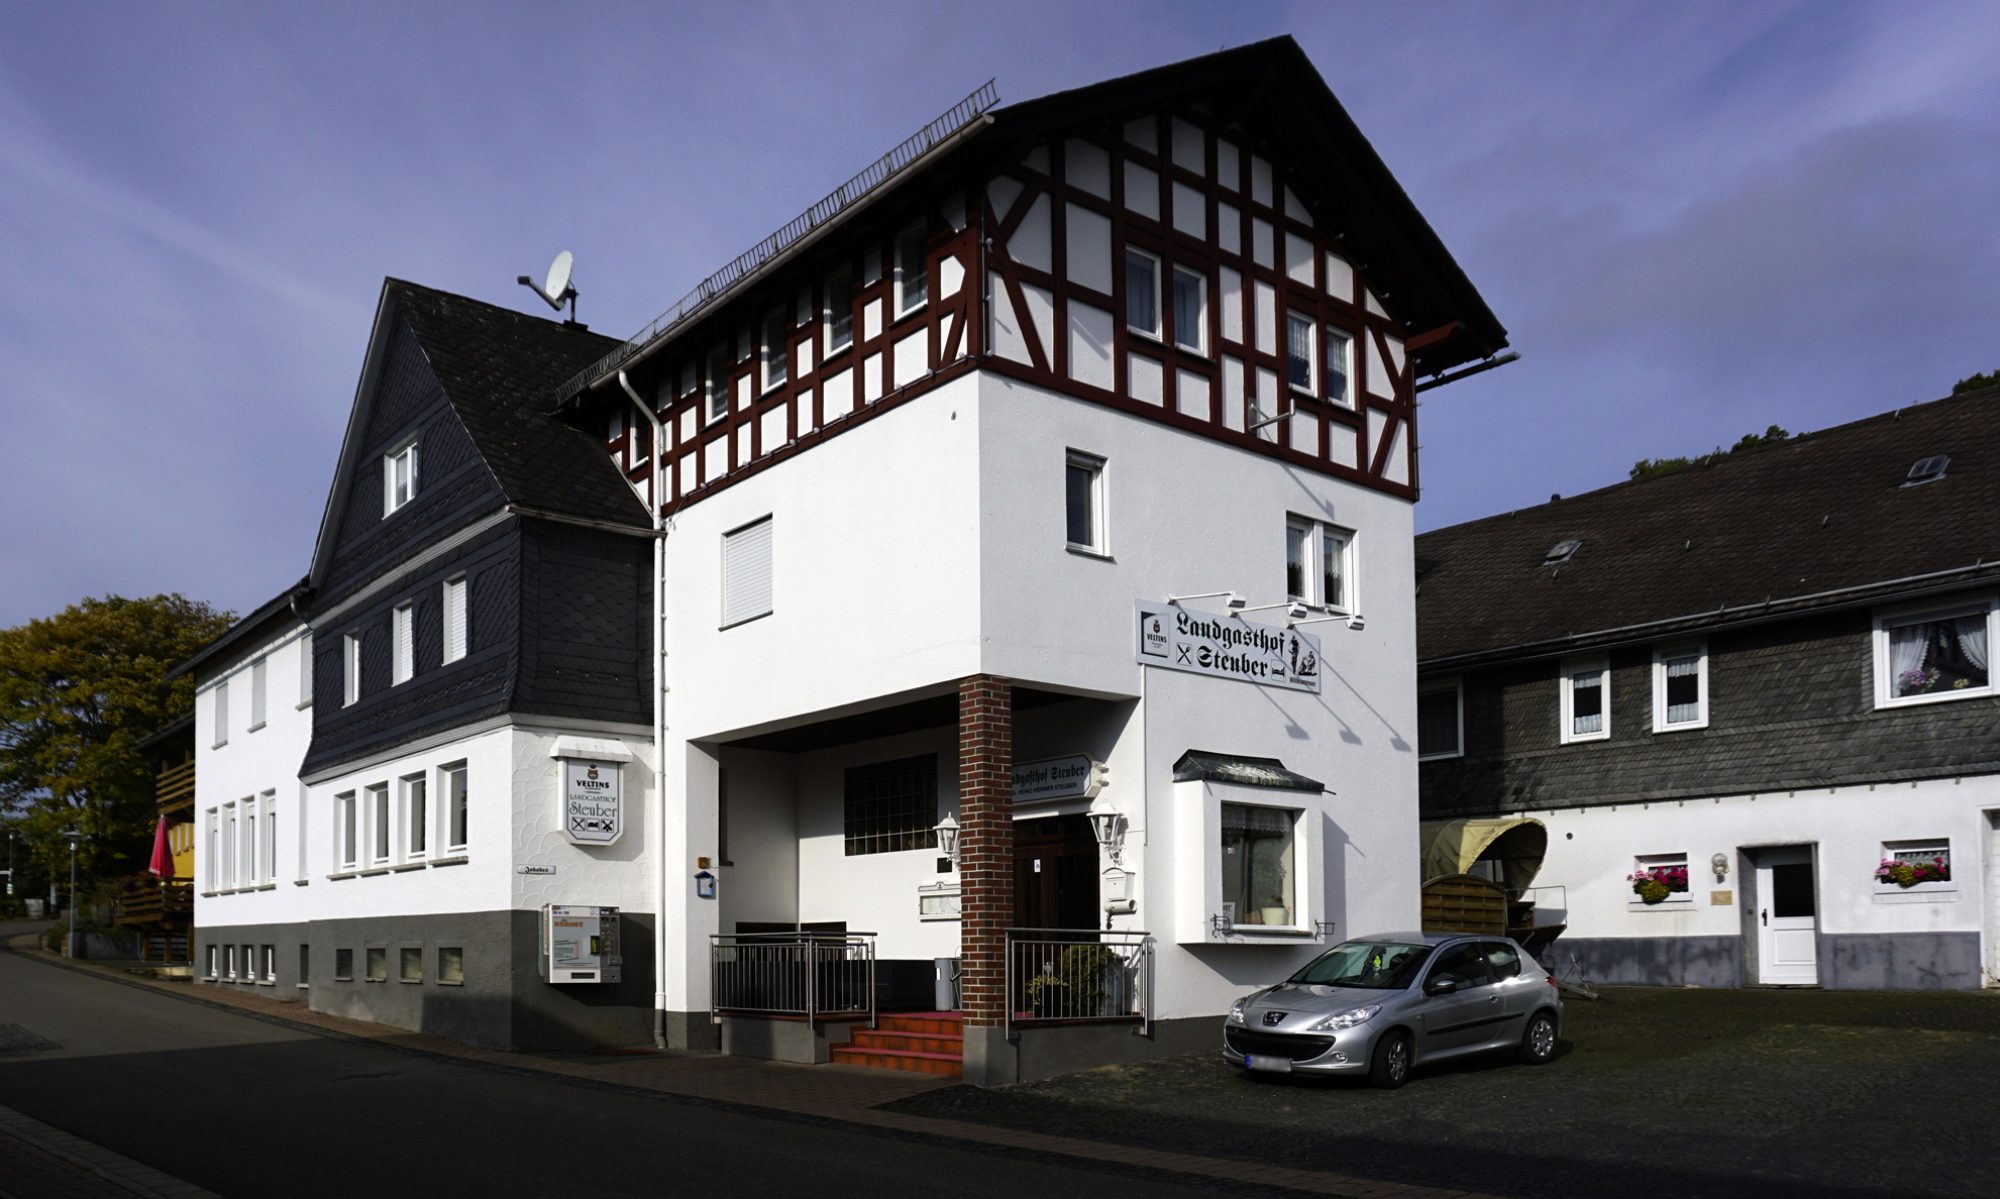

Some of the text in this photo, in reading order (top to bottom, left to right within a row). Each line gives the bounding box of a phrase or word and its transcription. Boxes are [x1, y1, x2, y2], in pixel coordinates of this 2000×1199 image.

[1147, 633, 1167, 643] VELTINS
[1176, 612, 1285, 658] Landgasthof
[1197, 645, 1268, 677] Steuber
[1051, 764, 1085, 780] Steuber
[576, 780, 610, 789] VELTINS
[570, 794, 616, 803] LANDGASTHOF
[569, 801, 617, 818] Steuber
